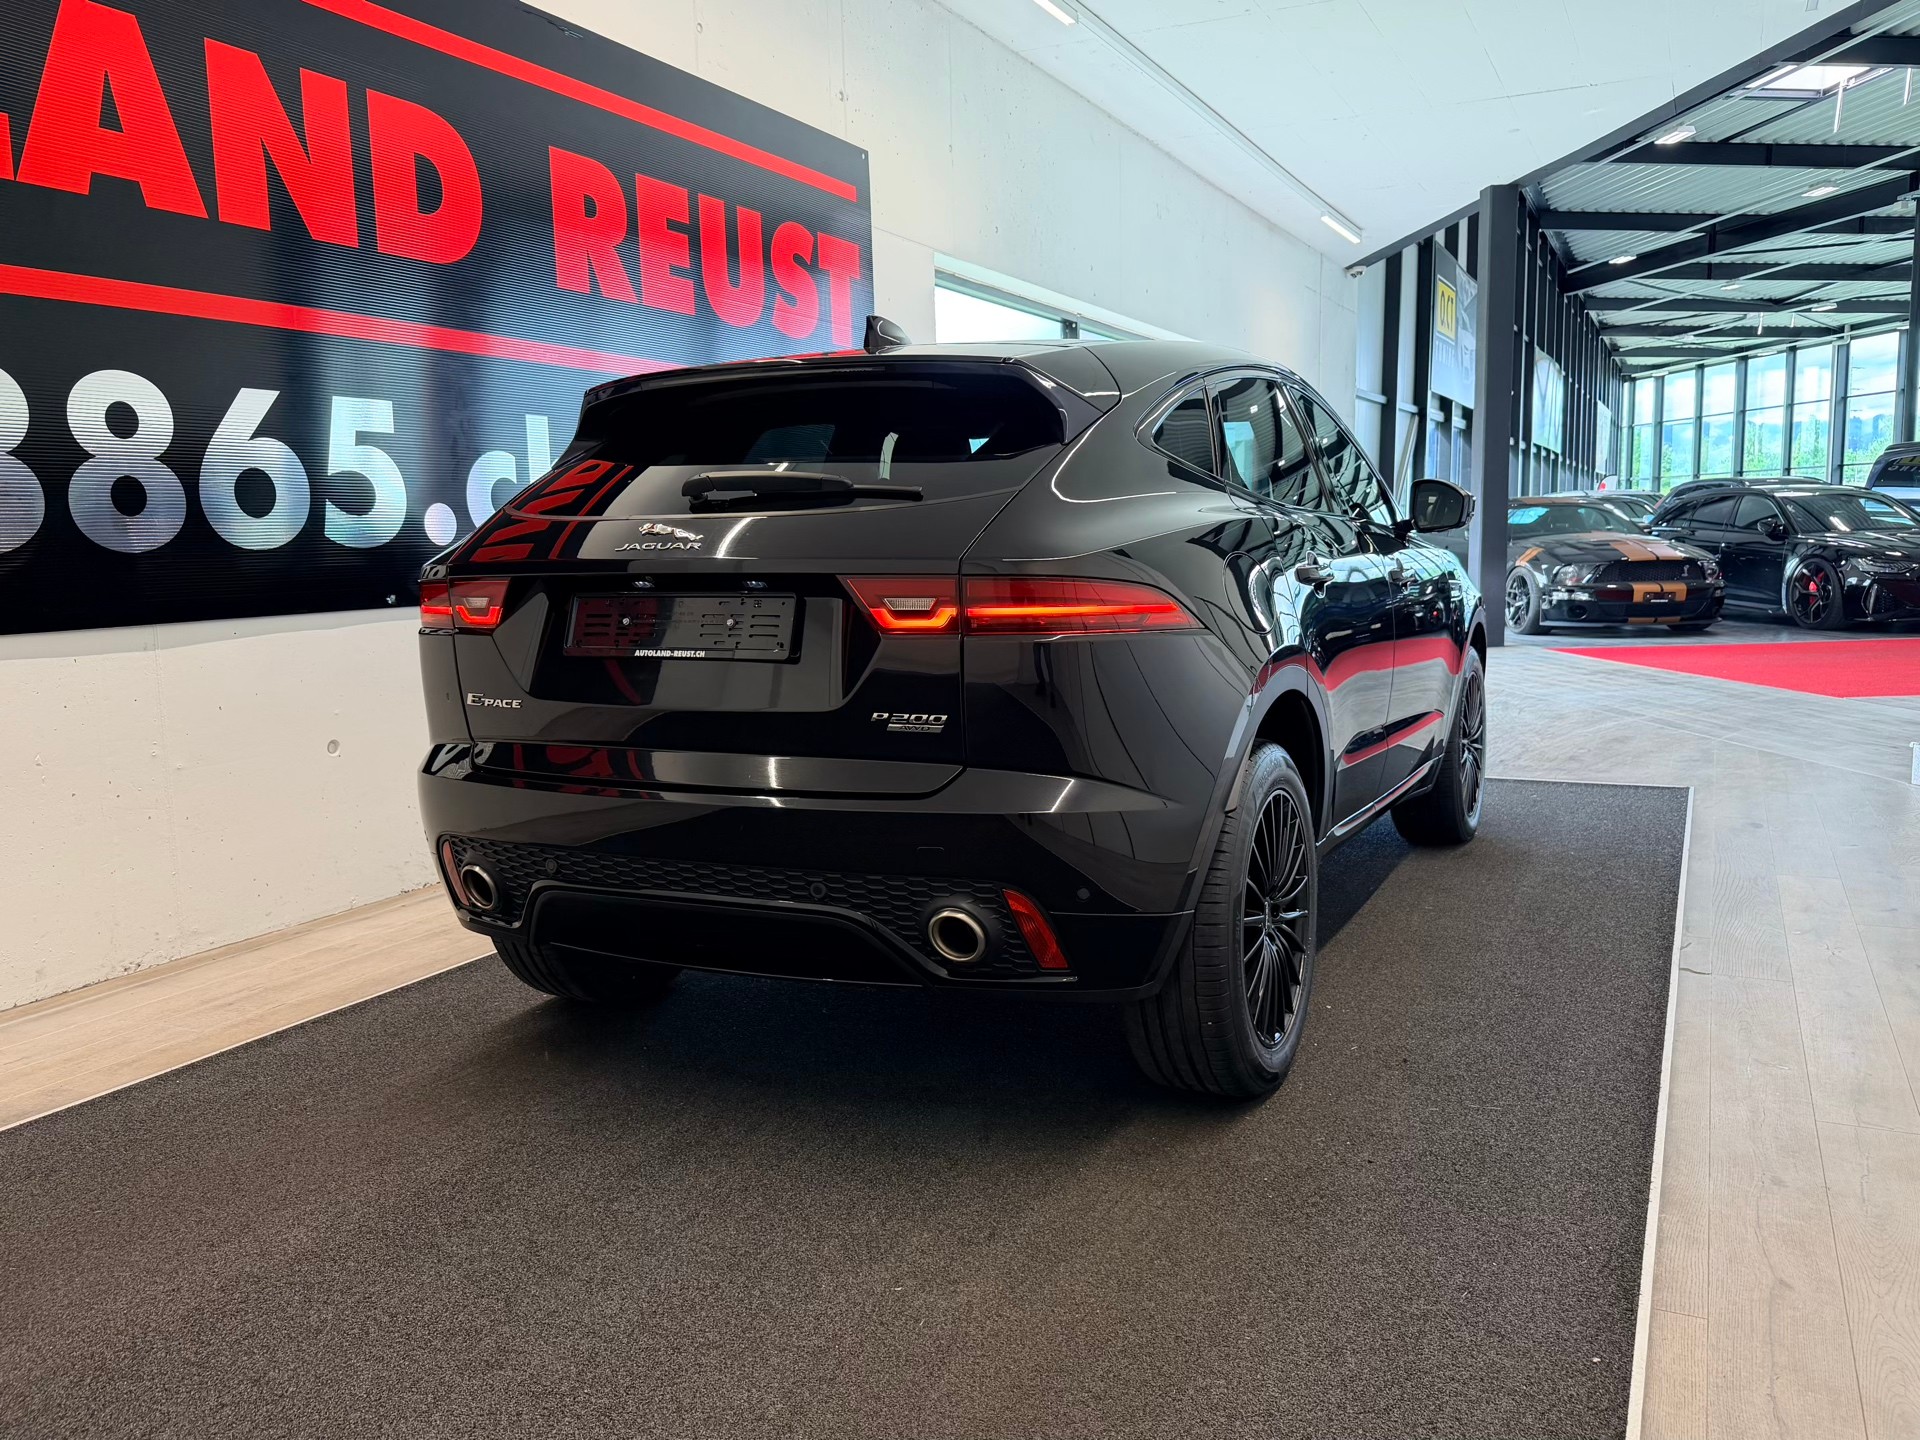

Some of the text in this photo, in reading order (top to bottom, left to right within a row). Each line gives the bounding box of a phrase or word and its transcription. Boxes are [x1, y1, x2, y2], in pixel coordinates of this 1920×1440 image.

[0, 0, 861, 349] AND REUST
[614, 542, 702, 552] JAGUAR
[634, 649, 706, 658] AUTOLAND-REUST.CH
